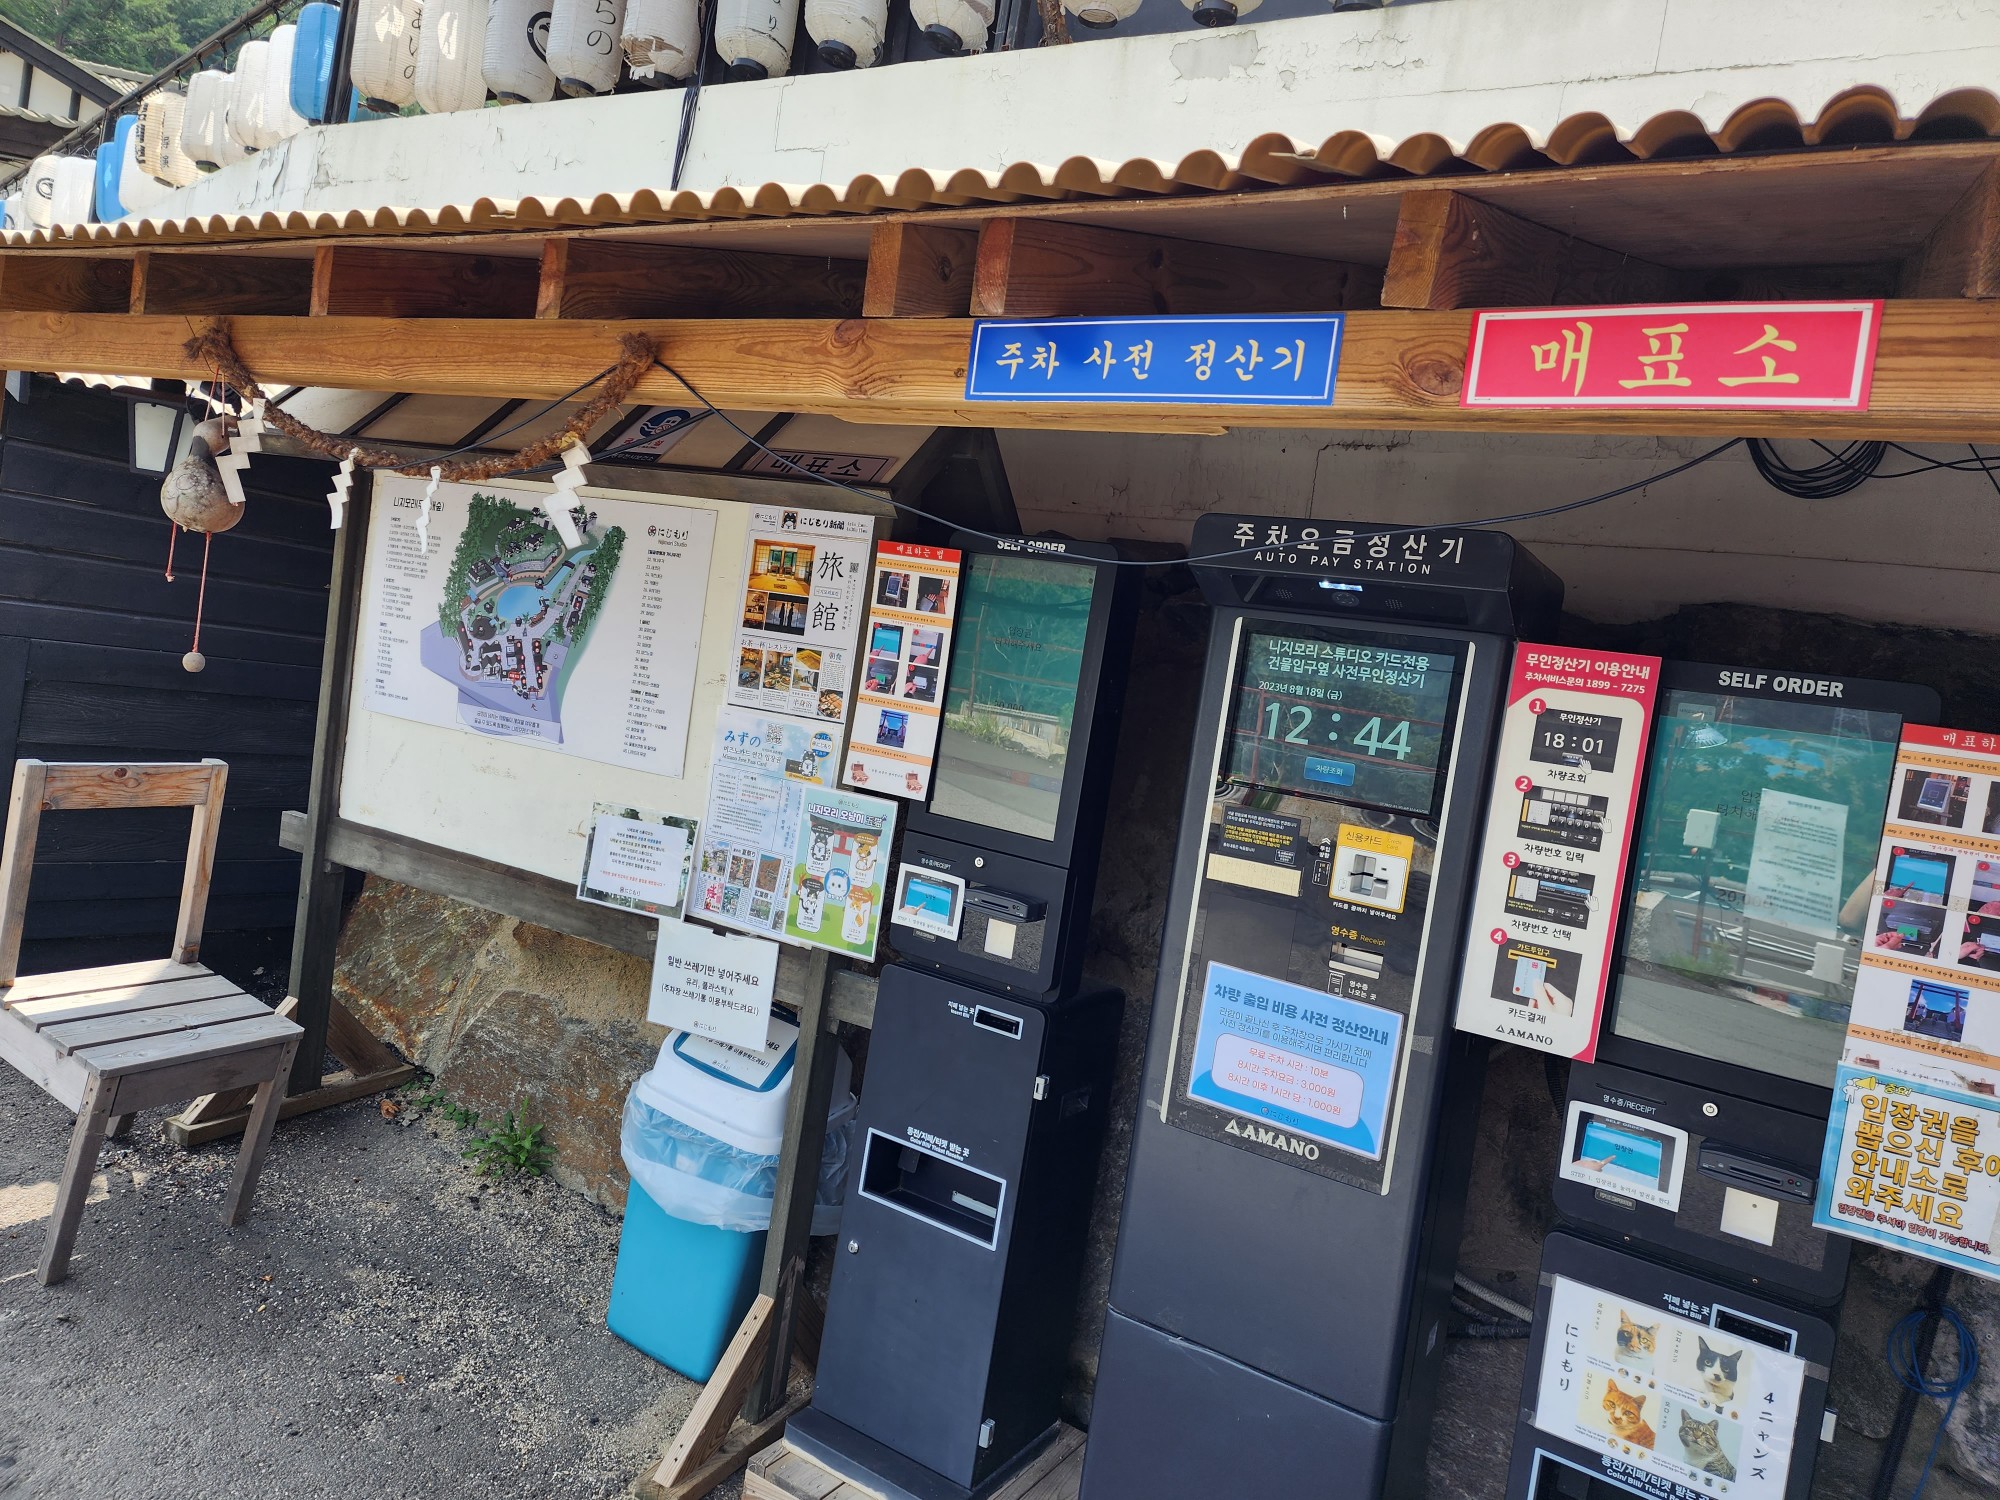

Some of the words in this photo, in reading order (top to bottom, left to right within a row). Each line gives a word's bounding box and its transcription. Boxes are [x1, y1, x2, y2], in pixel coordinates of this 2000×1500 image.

[996, 341, 1060, 380] 주차
[1083, 339, 1154, 380] 사전
[1185, 339, 1306, 381] 정산기
[1531, 321, 1800, 397] 매표소
[897, 544, 931, 558] 매표하는
[937, 550, 944, 560] 법
[1254, 551, 1297, 564] AUTO
[1310, 556, 1340, 568] PAY
[1354, 558, 1432, 575] STATION
[1269, 639, 1318, 658] 니지모리
[1320, 645, 1372, 664] 스튜디오
[1375, 651, 1430, 672] 카드전용
[1526, 653, 1591, 673] 무인정산기
[1594, 661, 1651, 680] 이용안내
[1268, 656, 1330, 677] 건물입구옆
[1332, 665, 1425, 688] 사전무인정산기
[1524, 671, 1584, 687] 주차서비스문의
[1586, 678, 1610, 689] 1899
[1621, 683, 1645, 694] 7275
[1258, 680, 1288, 694] 2023년
[1289, 683, 1303, 696] 8월
[1305, 686, 1324, 699] 18일
[1327, 688, 1343, 700] (금)
[1718, 670, 1768, 690] SELF
[1772, 676, 1844, 699] ORDER
[1533, 701, 1542, 712] 1
[1559, 713, 1602, 726] 무인정산기
[724, 730, 761, 748] みずの
[1315, 764, 1344, 776] 차량조회
[1547, 769, 1586, 784] 차량조회
[1519, 778, 1528, 789] 2
[1346, 832, 1382, 845] 신용카드
[1507, 855, 1516, 865] 3
[1524, 843, 1562, 858] 차량번호
[1565, 851, 1585, 863] 입력
[1333, 901, 1348, 910] 카드를
[1331, 925, 1358, 940] 영수증
[1360, 934, 1386, 946] Receipt
[1493, 931, 1503, 942] 4
[1511, 919, 1549, 935] 차량번호
[1552, 928, 1572, 941] 선택
[1517, 943, 1551, 956] 카드투입구
[667, 955, 682, 969] 일반
[684, 961, 715, 977] 쓰레기만
[718, 967, 760, 987] 넣어주세요
[1348, 988, 1367, 999] 나오는
[1349, 980, 1368, 990] 영수증
[1214, 983, 1241, 1002] 차량
[1243, 992, 1269, 1011] 출입
[1272, 1000, 1298, 1019] 비용
[1300, 1008, 1328, 1028] 사전
[1332, 1017, 1389, 1045] 정산안내
[1508, 1007, 1546, 1024] 카드결제
[1219, 1017, 1236, 1028] 사전
[1272, 1032, 1322, 1055] 이용해주시면
[1324, 1047, 1368, 1068] 편리합니다
[1282, 1024, 1324, 1044] 주차장으로
[1326, 1038, 1351, 1053] 가시기
[1354, 1046, 1372, 1059] 전에
[1507, 1028, 1553, 1046] AMANO
[1249, 1047, 1266, 1059] 무료
[1268, 1053, 1284, 1065] 주차
[1287, 1058, 1303, 1071] 시간
[1310, 1066, 1329, 1079] 10분
[1237, 1060, 1260, 1073] 8시간
[1262, 1067, 1294, 1085] 주차요금
[1300, 1080, 1336, 1097] 3,000원
[1227, 1073, 1250, 1086] 8시간
[1252, 1080, 1268, 1091] 이후
[1270, 1085, 1291, 1100] 1시간
[1308, 1097, 1341, 1115] 1,000원
[1603, 1094, 1657, 1116] 영수증/RECEIPT
[1860, 1094, 1981, 1147] 입장권을
[1242, 1124, 1320, 1161] AMANO
[1855, 1120, 1944, 1167] 뽑으신
[1595, 1177, 1617, 1189] 입장권을
[1851, 1150, 1969, 1201] 안내소로
[1844, 1177, 1964, 1230] 와주세요
[1837, 1203, 1875, 1222] 입장권을
[1877, 1213, 1907, 1231] 주셔야
[1908, 1222, 1937, 1240] 입장이
[1939, 1231, 1992, 1255] 가능합니다.
[1663, 1293, 1680, 1306] 지폐
[1682, 1299, 1699, 1312] 넣는
[1701, 1305, 1710, 1316] 곳
[1668, 1303, 1689, 1316] Insert
[1689, 1311, 1702, 1320] Bill
[1559, 1322, 1579, 1392] にじもり
[1750, 1391, 1776, 1481] 4ニャンズ
[1601, 1454, 1671, 1492] 동전/지폐/티켓
[1675, 1484, 1697, 1500] 받는
[1606, 1468, 1628, 1485] Coin/
[1644, 1481, 1668, 1497] Ticket
